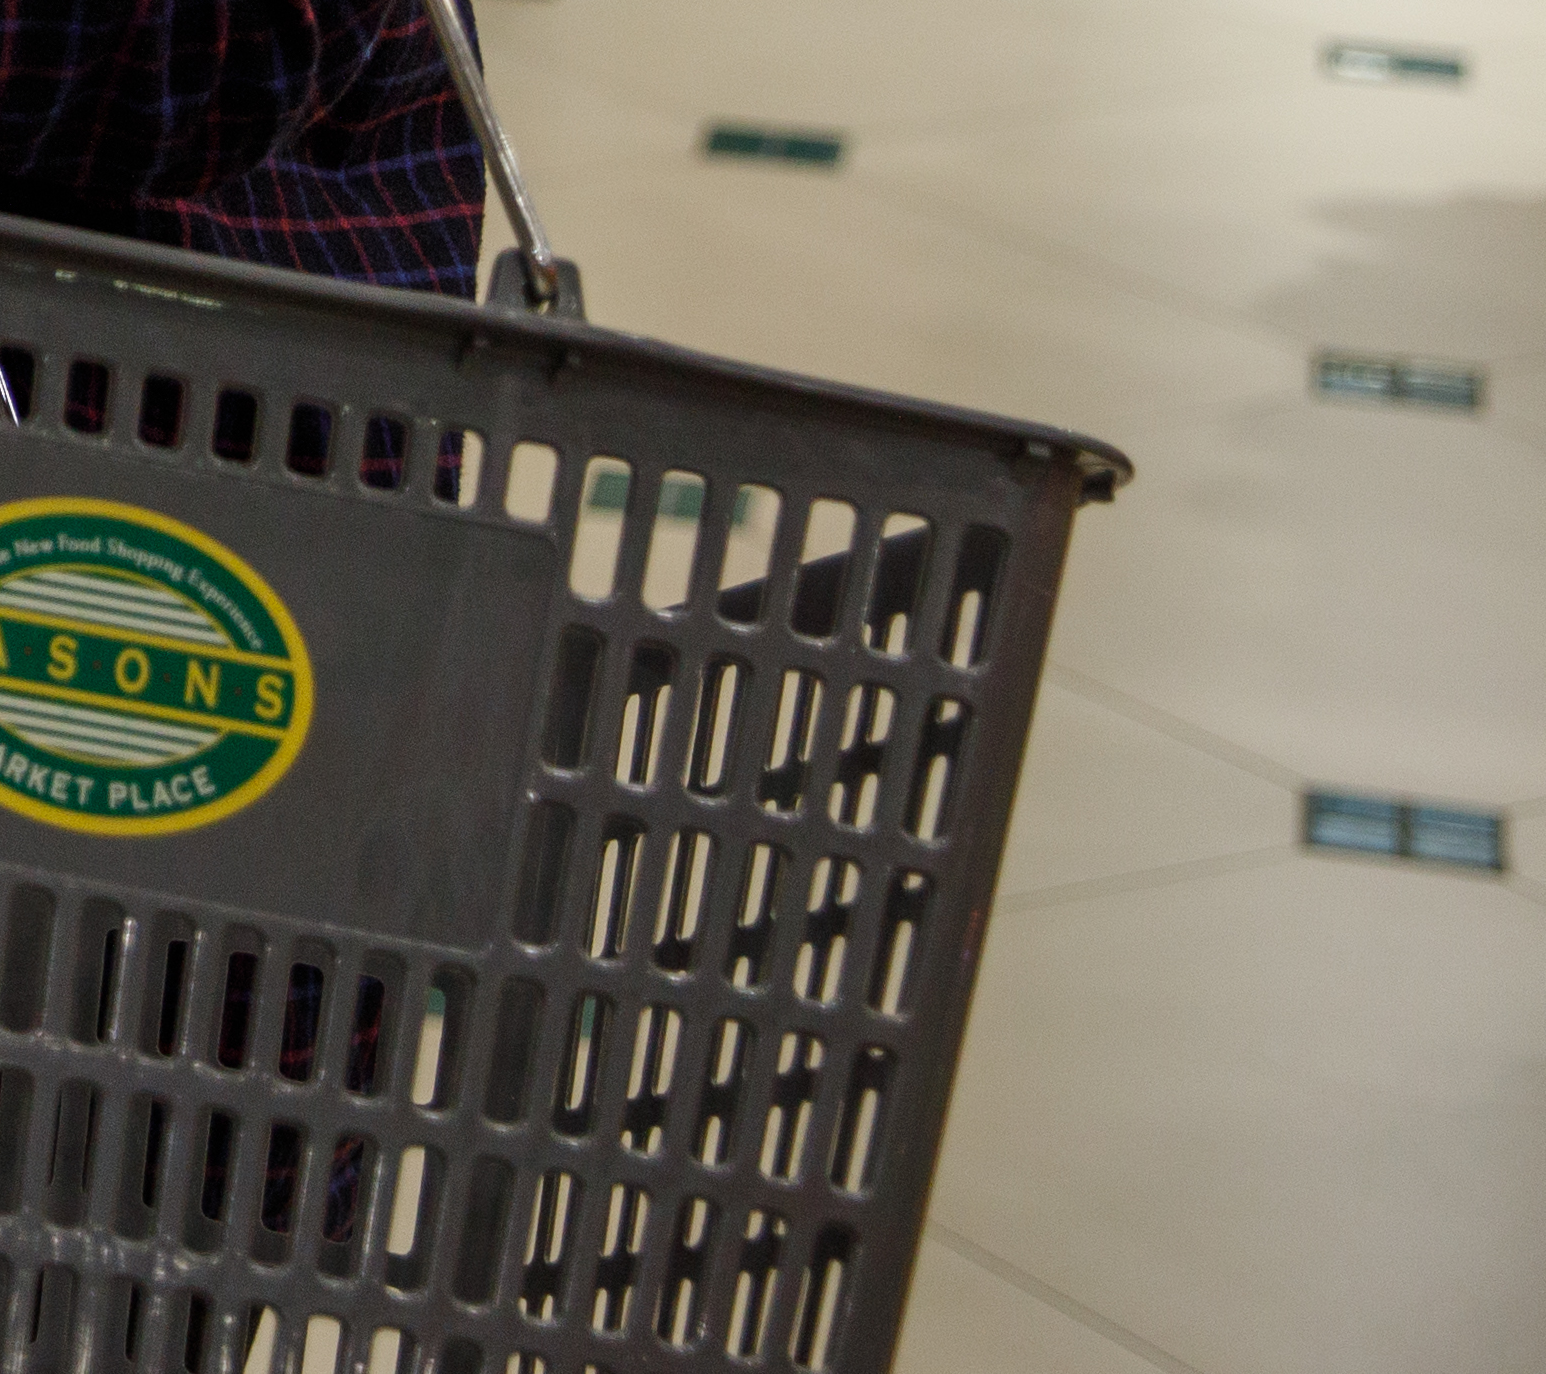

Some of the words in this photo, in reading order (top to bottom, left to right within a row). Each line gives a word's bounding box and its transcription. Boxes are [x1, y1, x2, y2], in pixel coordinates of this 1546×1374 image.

[14, 537, 53, 554] New
[58, 535, 101, 554] Food
[108, 537, 183, 583] Shopping
[188, 568, 264, 650] Experience
[108, 764, 217, 811] PLACE
